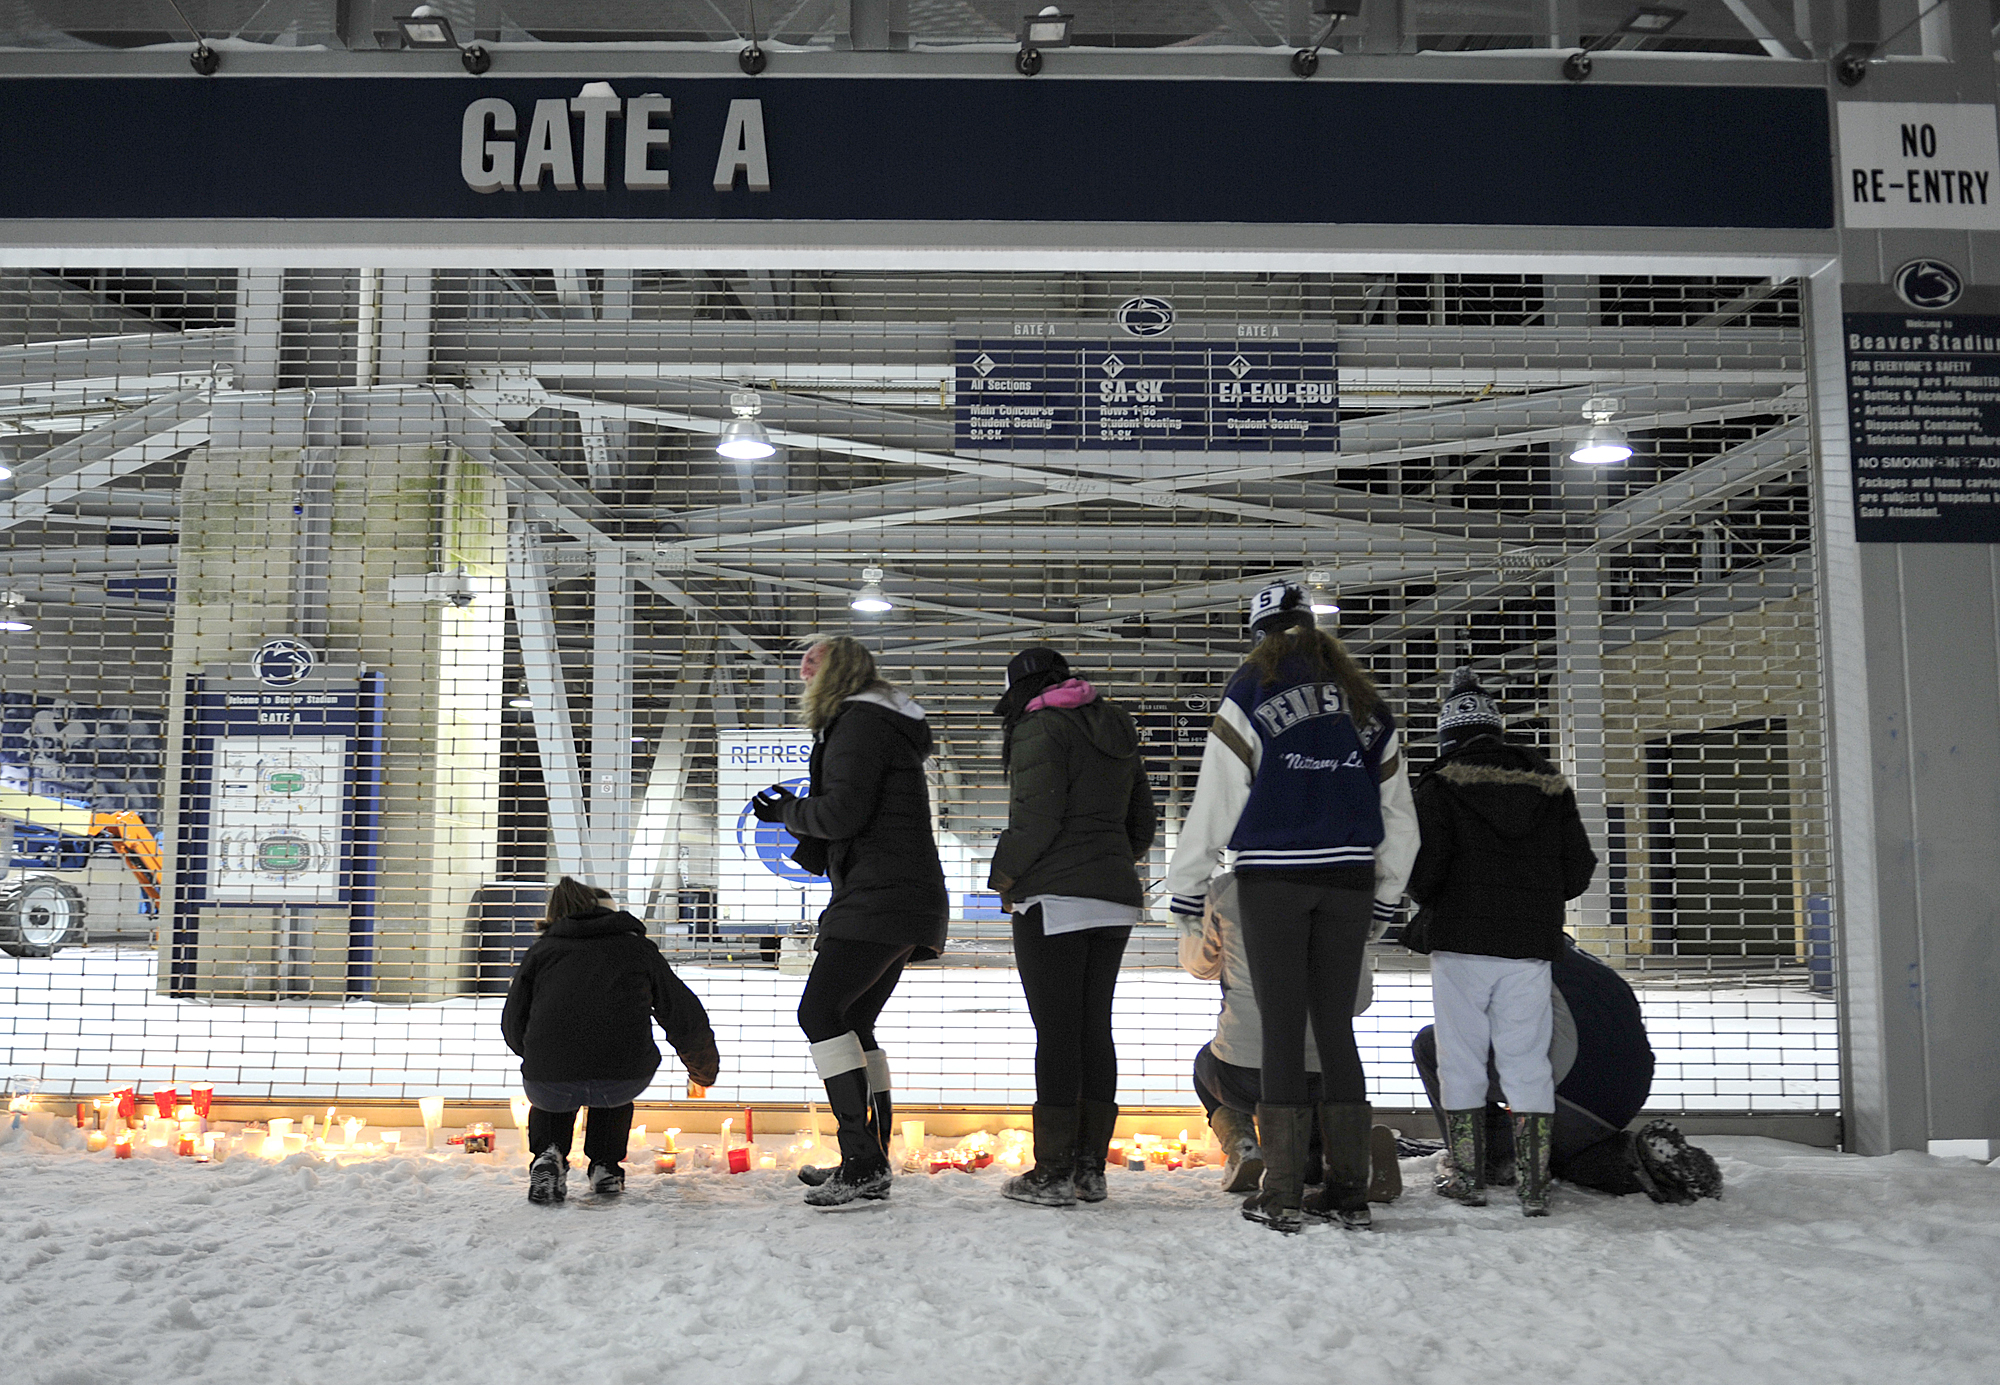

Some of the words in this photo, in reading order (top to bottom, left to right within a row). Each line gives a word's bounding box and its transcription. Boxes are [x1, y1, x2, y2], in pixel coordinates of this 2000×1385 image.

[461, 97, 672, 193] GATE
[713, 98, 770, 192] A
[1901, 123, 1937, 158] NO
[1852, 168, 1989, 205] RE-ENTRY
[1014, 324, 1043, 336] GATE
[1048, 324, 1056, 336] A
[1237, 325, 1267, 337] GATE
[1271, 326, 1279, 337] A
[1943, 320, 1953, 329] to
[1849, 333, 1923, 351] Beaver
[1851, 360, 1871, 372] FOR
[1873, 360, 1933, 372] EVERYONE'S
[1935, 360, 1972, 373] SAFETY
[970, 380, 984, 390] All
[987, 380, 1032, 391] Sections
[1100, 380, 1164, 402] SA-SK
[1219, 382, 1333, 404] EA-EAU-EBU
[1903, 390, 1913, 401] &
[970, 404, 996, 416] Main
[999, 404, 1055, 416] Concourse
[1100, 404, 1129, 416] Rows
[970, 416, 1010, 428] Student
[1013, 416, 1052, 430] Seating
[1100, 417, 1140, 428] Student
[1143, 417, 1182, 430] Seating
[1227, 417, 1268, 430] Student
[1270, 418, 1309, 431] Seating
[1858, 456, 1879, 469] NO
[1923, 492, 1936, 503] to
[1860, 506, 1885, 518] Gate
[1260, 591, 1272, 608] S
[262, 695, 272, 704] to
[306, 694, 338, 704] Stadium
[1257, 685, 1320, 733] PENN
[260, 712, 291, 724] GATE
[294, 712, 301, 723] A
[731, 744, 811, 764] REFRES
